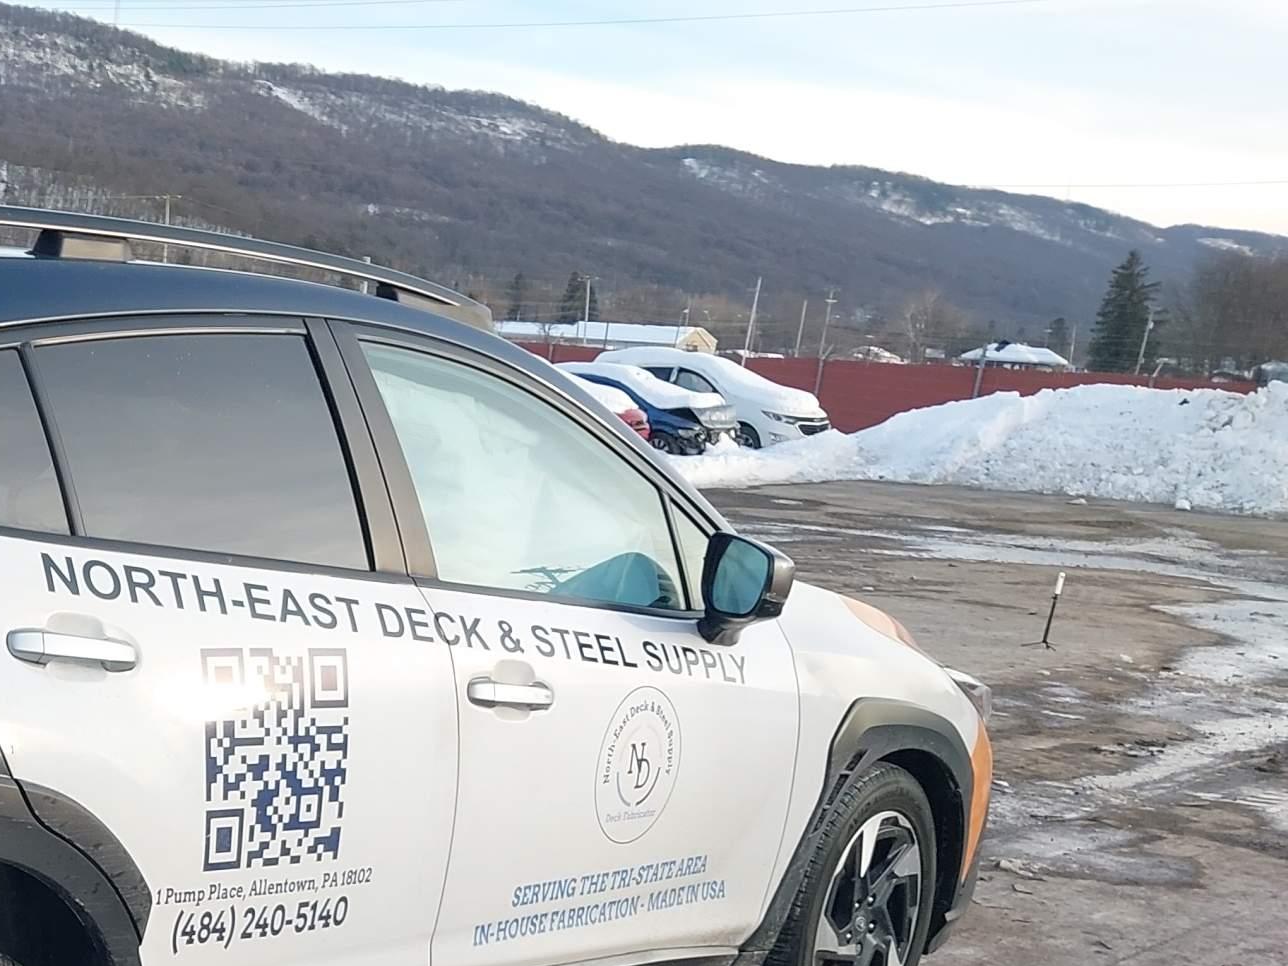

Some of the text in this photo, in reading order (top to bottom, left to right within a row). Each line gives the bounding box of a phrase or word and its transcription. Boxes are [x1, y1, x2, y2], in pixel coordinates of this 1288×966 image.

[41, 552, 746, 685] NORTH-EAST DECK & STEEL SUPPLY
[156, 867, 373, 906] 1 Pump Place, Allentown, PA 18102
[511, 855, 708, 907] SERVING THE TRI-STATE AREA
[172, 896, 348, 955] (484) 240-5140
[473, 912, 548, 946] IN-HOUSE
[548, 895, 641, 931] FABRICATION
[647, 888, 683, 912] MADE
[682, 884, 701, 905] IN
[701, 880, 726, 900] USA
